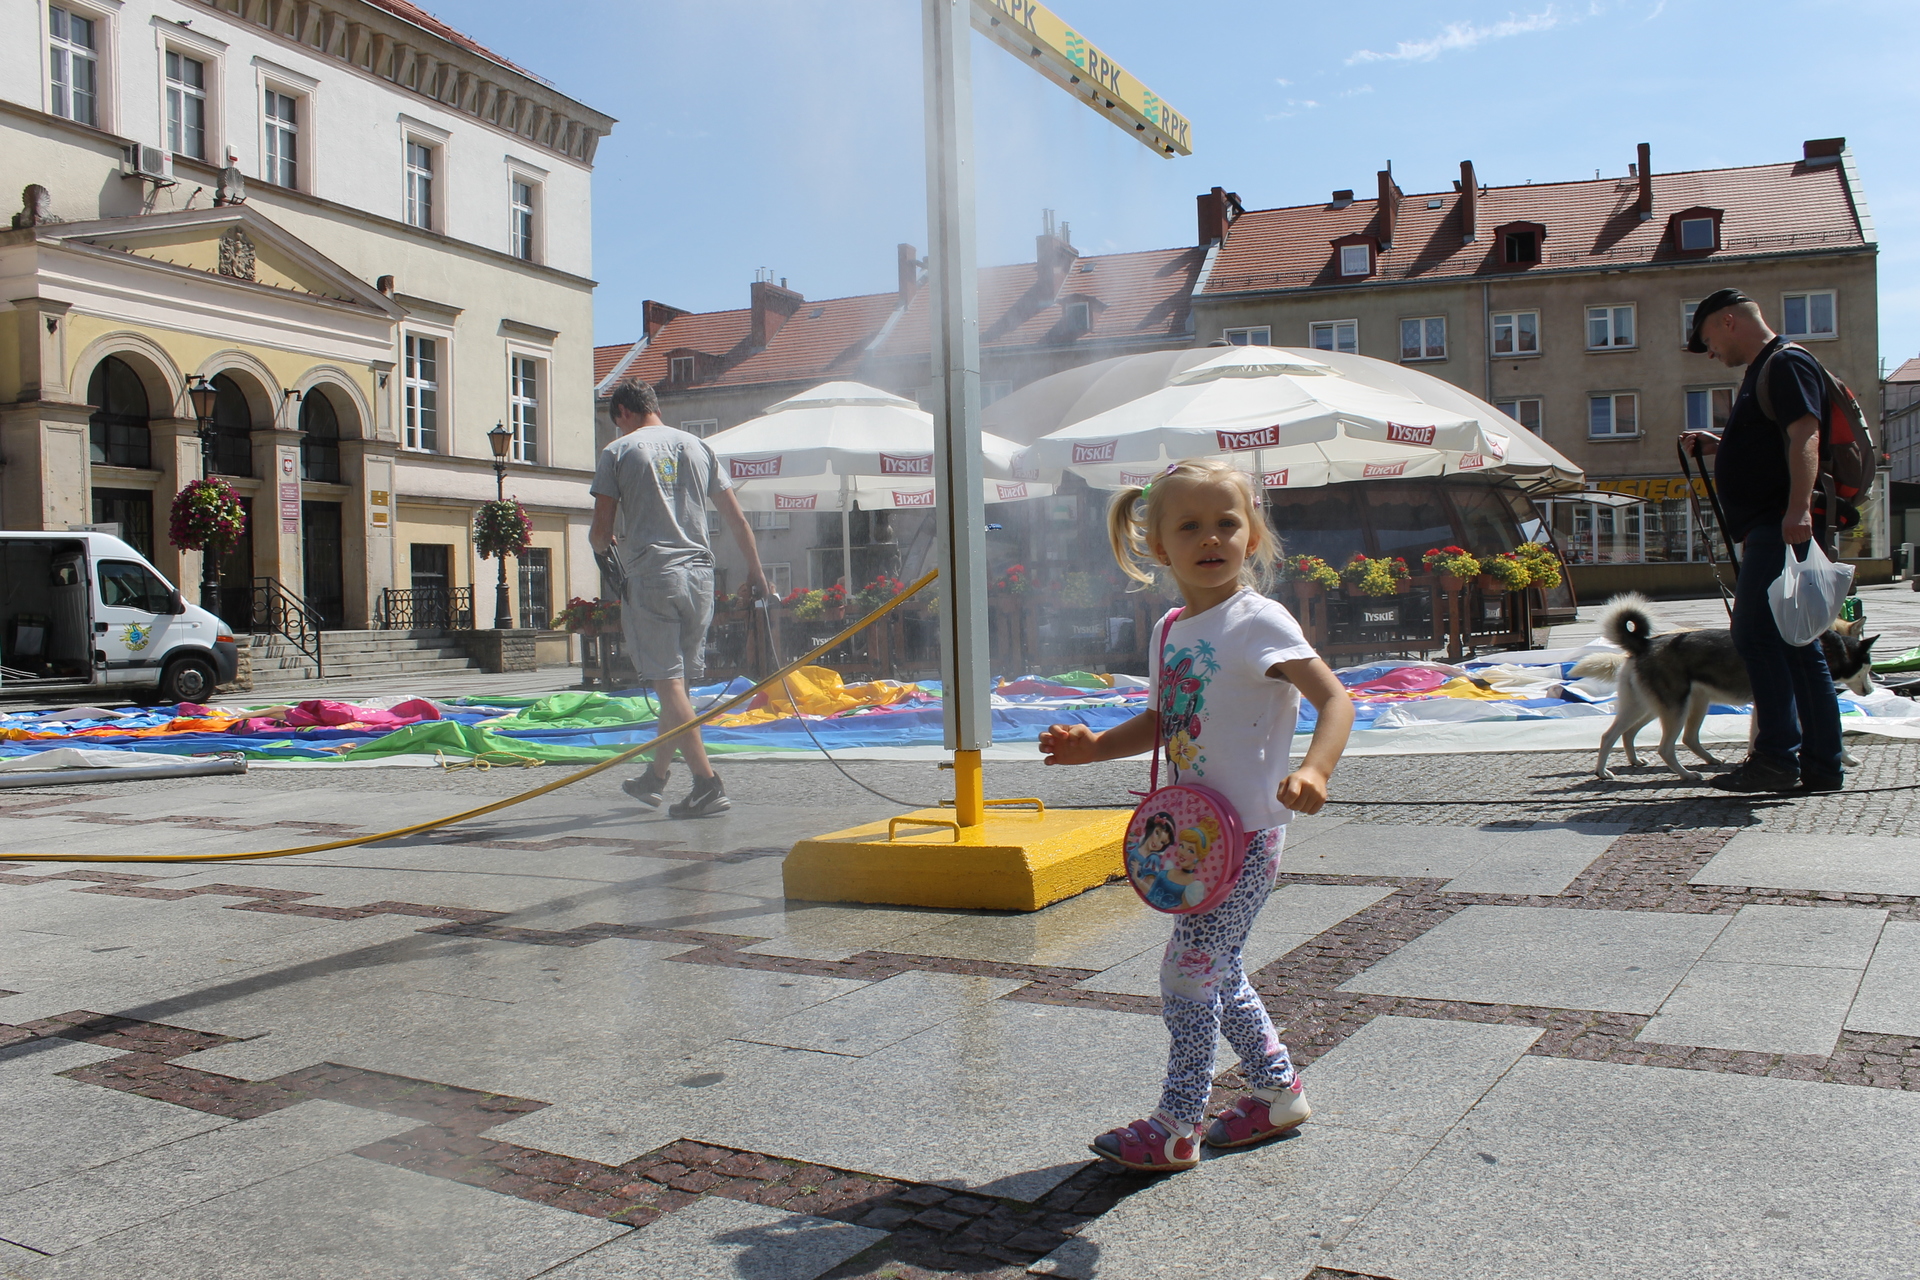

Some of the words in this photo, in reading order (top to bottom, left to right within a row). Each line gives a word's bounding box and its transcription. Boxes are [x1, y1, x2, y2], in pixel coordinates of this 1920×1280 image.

[1089, 48, 1121, 97] RPK
[1161, 105, 1189, 148] RPK
[1220, 427, 1277, 448] TYSKIE
[1391, 423, 1433, 443] TYSKIE
[1075, 443, 1114, 461] TYSKIE
[733, 460, 778, 477] TYSKIE
[883, 456, 929, 473] TYSKIE
[1364, 610, 1395, 622] TYSKIE
[1072, 624, 1101, 634] TYSKIE
